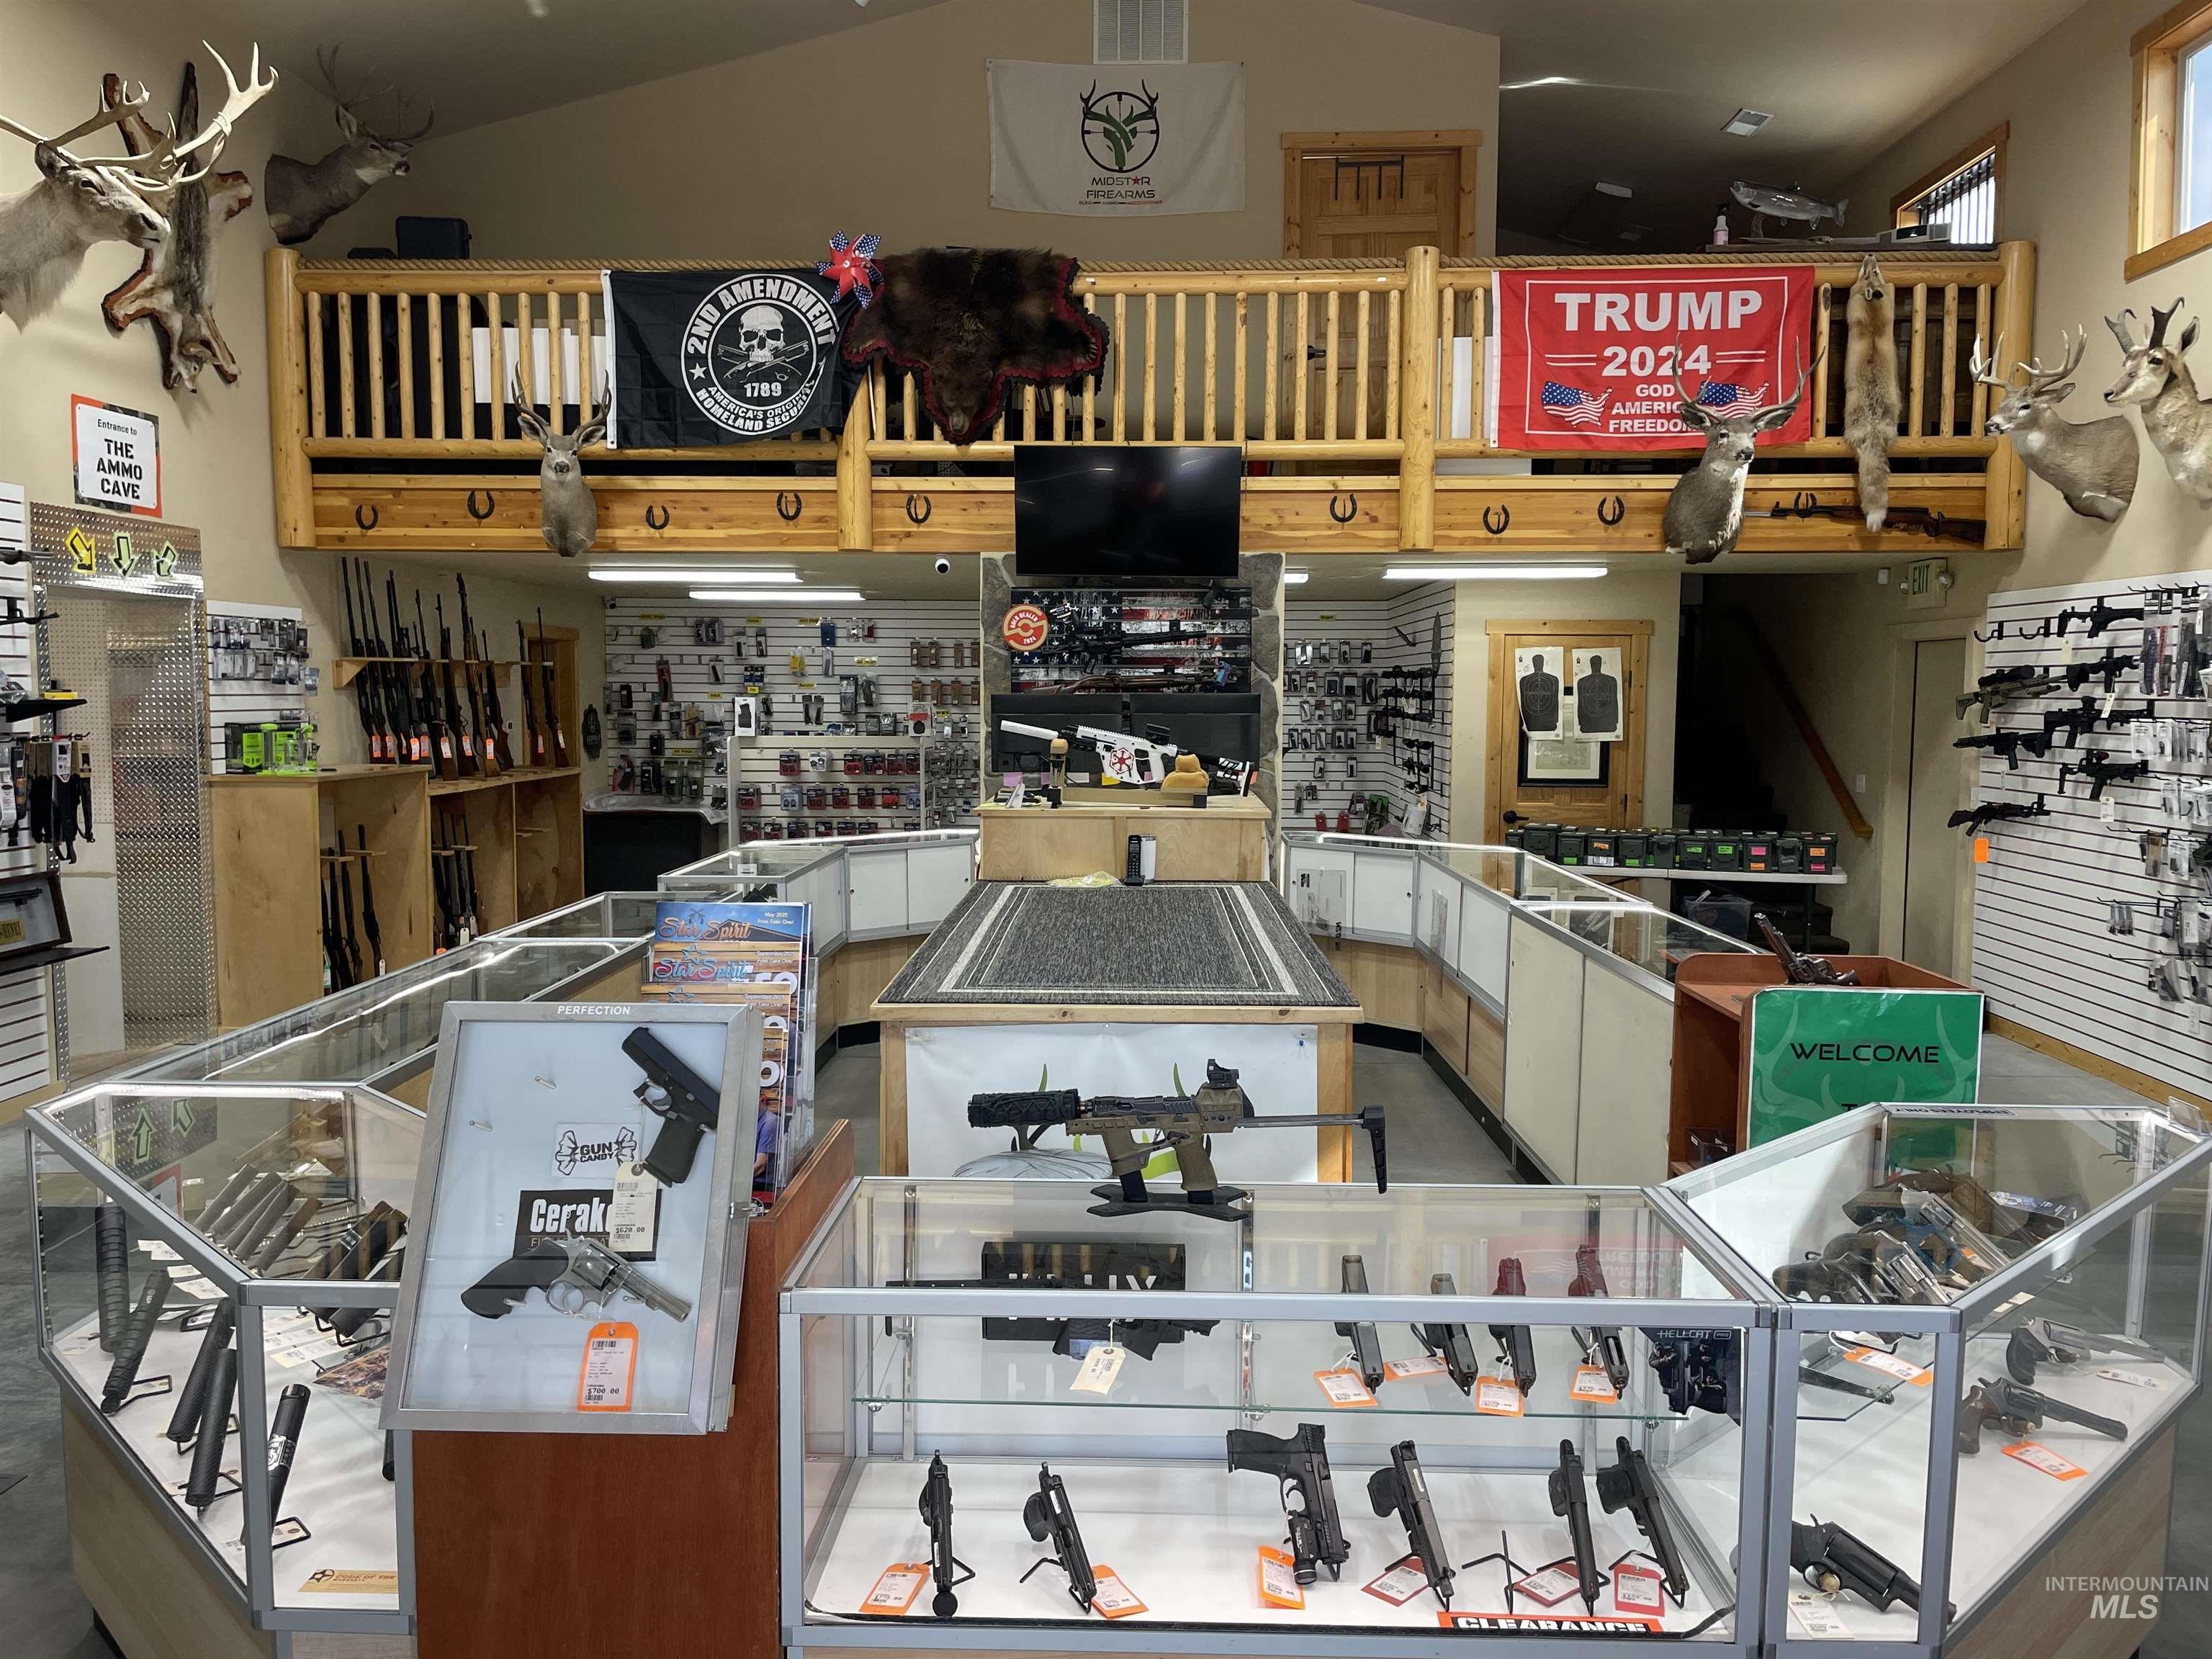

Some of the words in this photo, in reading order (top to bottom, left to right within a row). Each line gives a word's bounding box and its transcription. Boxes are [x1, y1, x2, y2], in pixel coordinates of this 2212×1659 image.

[1087, 189, 1155, 199] FIREARMS
[687, 303, 721, 354] 2ND
[718, 279, 837, 346] AMENDMENT
[1555, 290, 1762, 331] TRUMP
[1601, 345, 1712, 377] 2024
[744, 382, 782, 397] 1789
[1635, 384, 1676, 397] GOD
[696, 388, 763, 431] HOMELAND
[708, 386, 763, 418] AMERICA'S
[1611, 401, 1682, 415] AMERIC
[98, 418, 129, 433] Entrance
[130, 427, 138, 436] to
[104, 439, 134, 459] THE
[97, 457, 143, 480] AMMO
[101, 478, 140, 500] CAVE
[1912, 564, 1930, 595] EXIT
[1019, 612, 1038, 622] DEALER
[659, 917, 702, 940] Star
[702, 921, 752, 941] Spirit
[655, 958, 696, 980] Star
[696, 958, 750, 981] Spirit
[557, 1005, 631, 1015] PERFECTION
[1789, 1043, 1939, 1063] WELCOME
[580, 1141, 612, 1156] GUN
[580, 1153, 613, 1163] CANDY
[1657, 1329, 1712, 1339] HELLCAT
[1457, 1617, 1647, 1632] CLEARANCE
